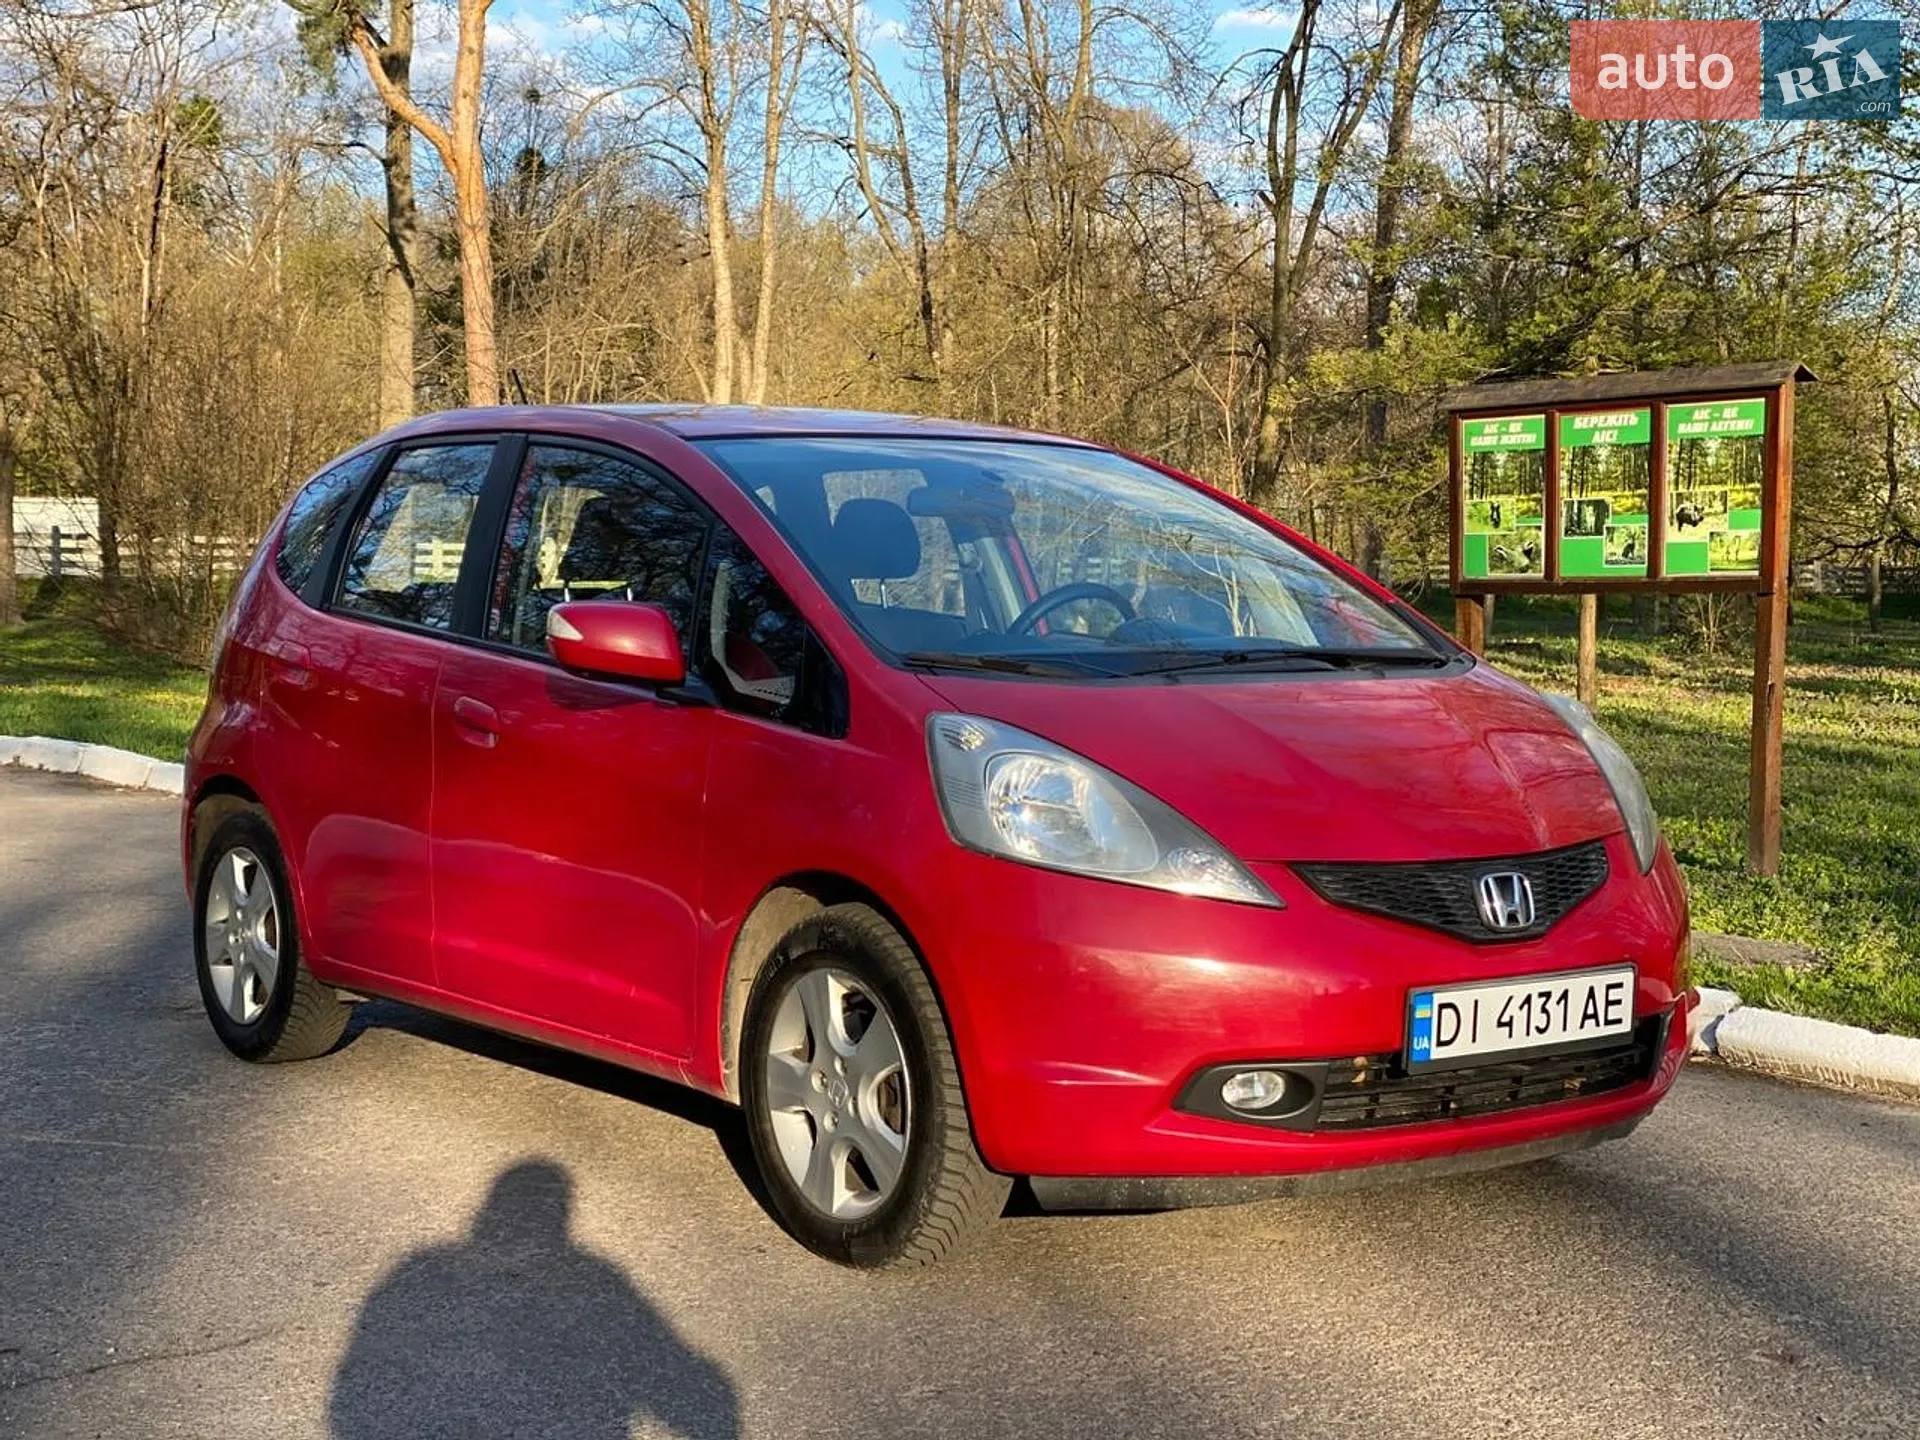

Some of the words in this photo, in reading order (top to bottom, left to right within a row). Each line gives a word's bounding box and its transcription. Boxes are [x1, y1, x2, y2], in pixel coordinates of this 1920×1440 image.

[1572, 412, 1639, 429] БЕРЕЖІТЬ
[1435, 999, 1478, 1047] DI
[1496, 988, 1569, 1039] 4131
[1579, 982, 1624, 1030] AE
[1413, 1036, 1429, 1051] UA
